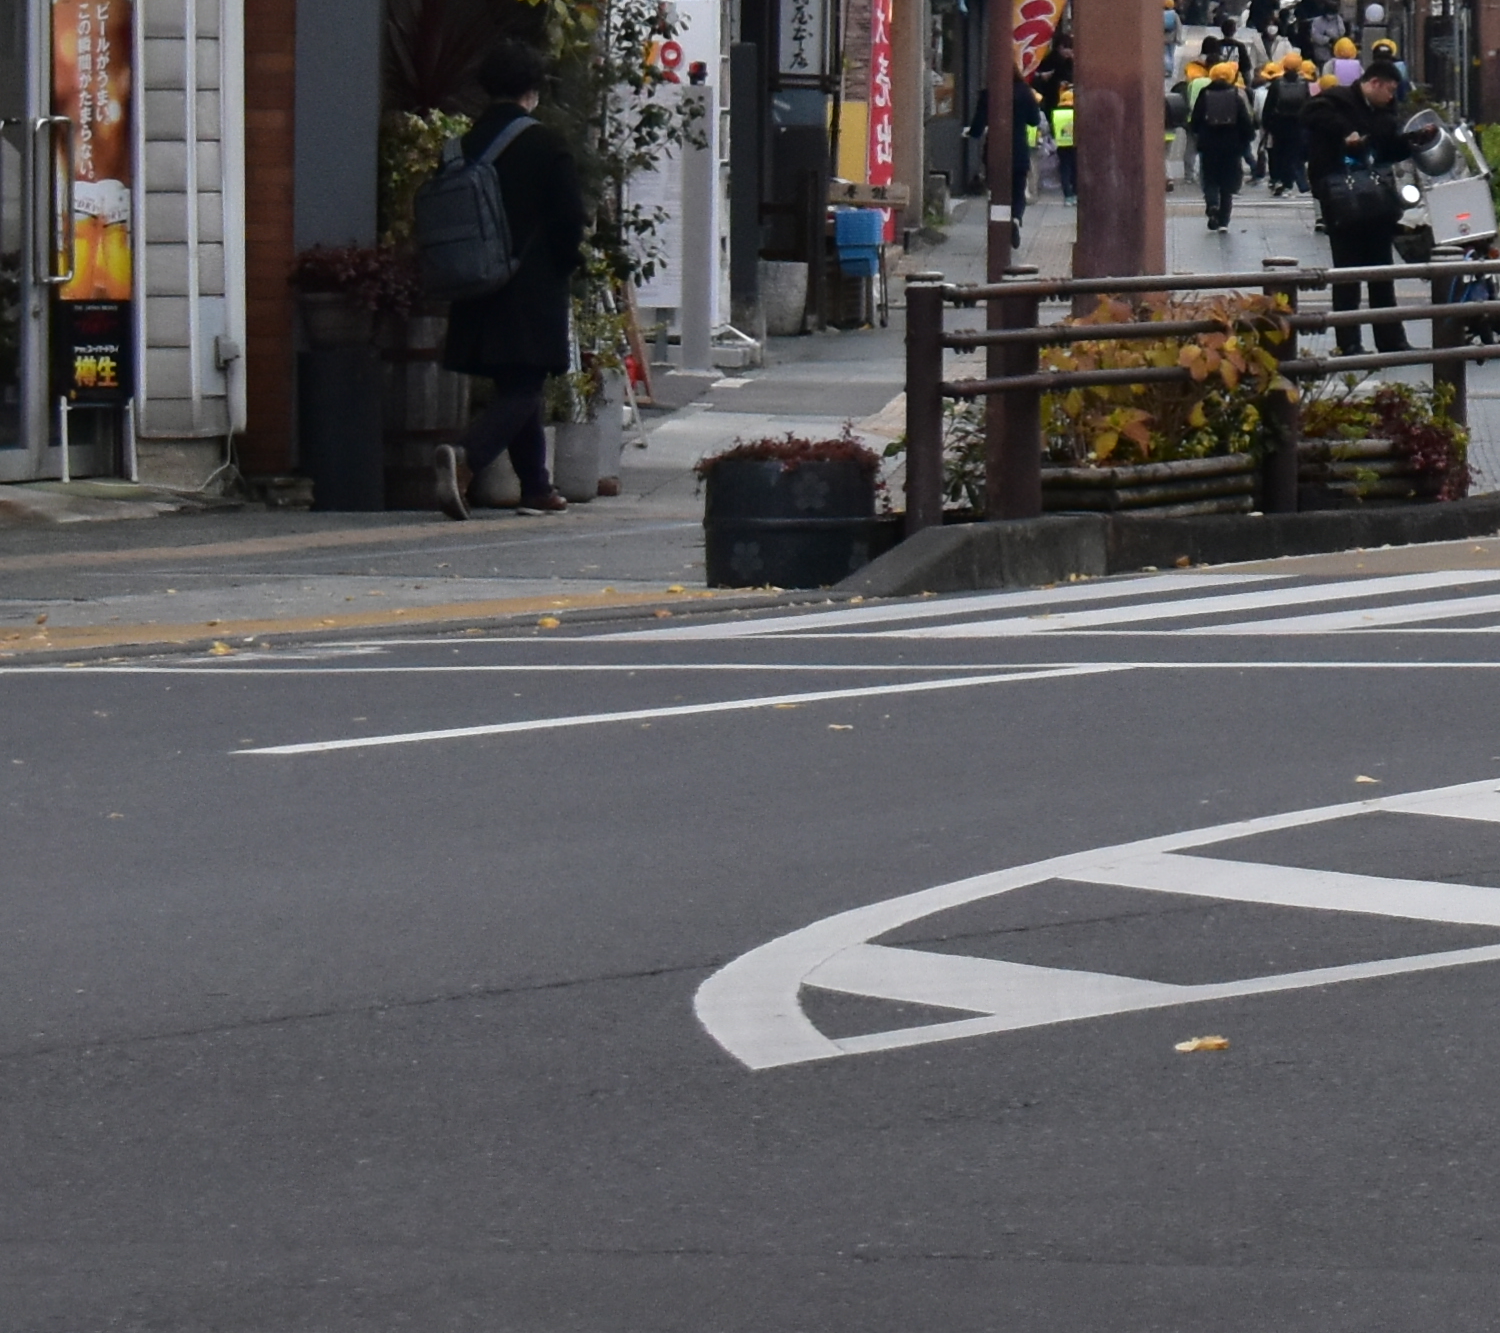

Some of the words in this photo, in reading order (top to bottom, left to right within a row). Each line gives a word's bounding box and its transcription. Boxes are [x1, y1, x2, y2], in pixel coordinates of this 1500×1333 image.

[77, 2, 95, 179] この瞬間がたまらない。
[96, 1, 111, 126] ビールがうまい。
[74, 355, 119, 387] 樽生
